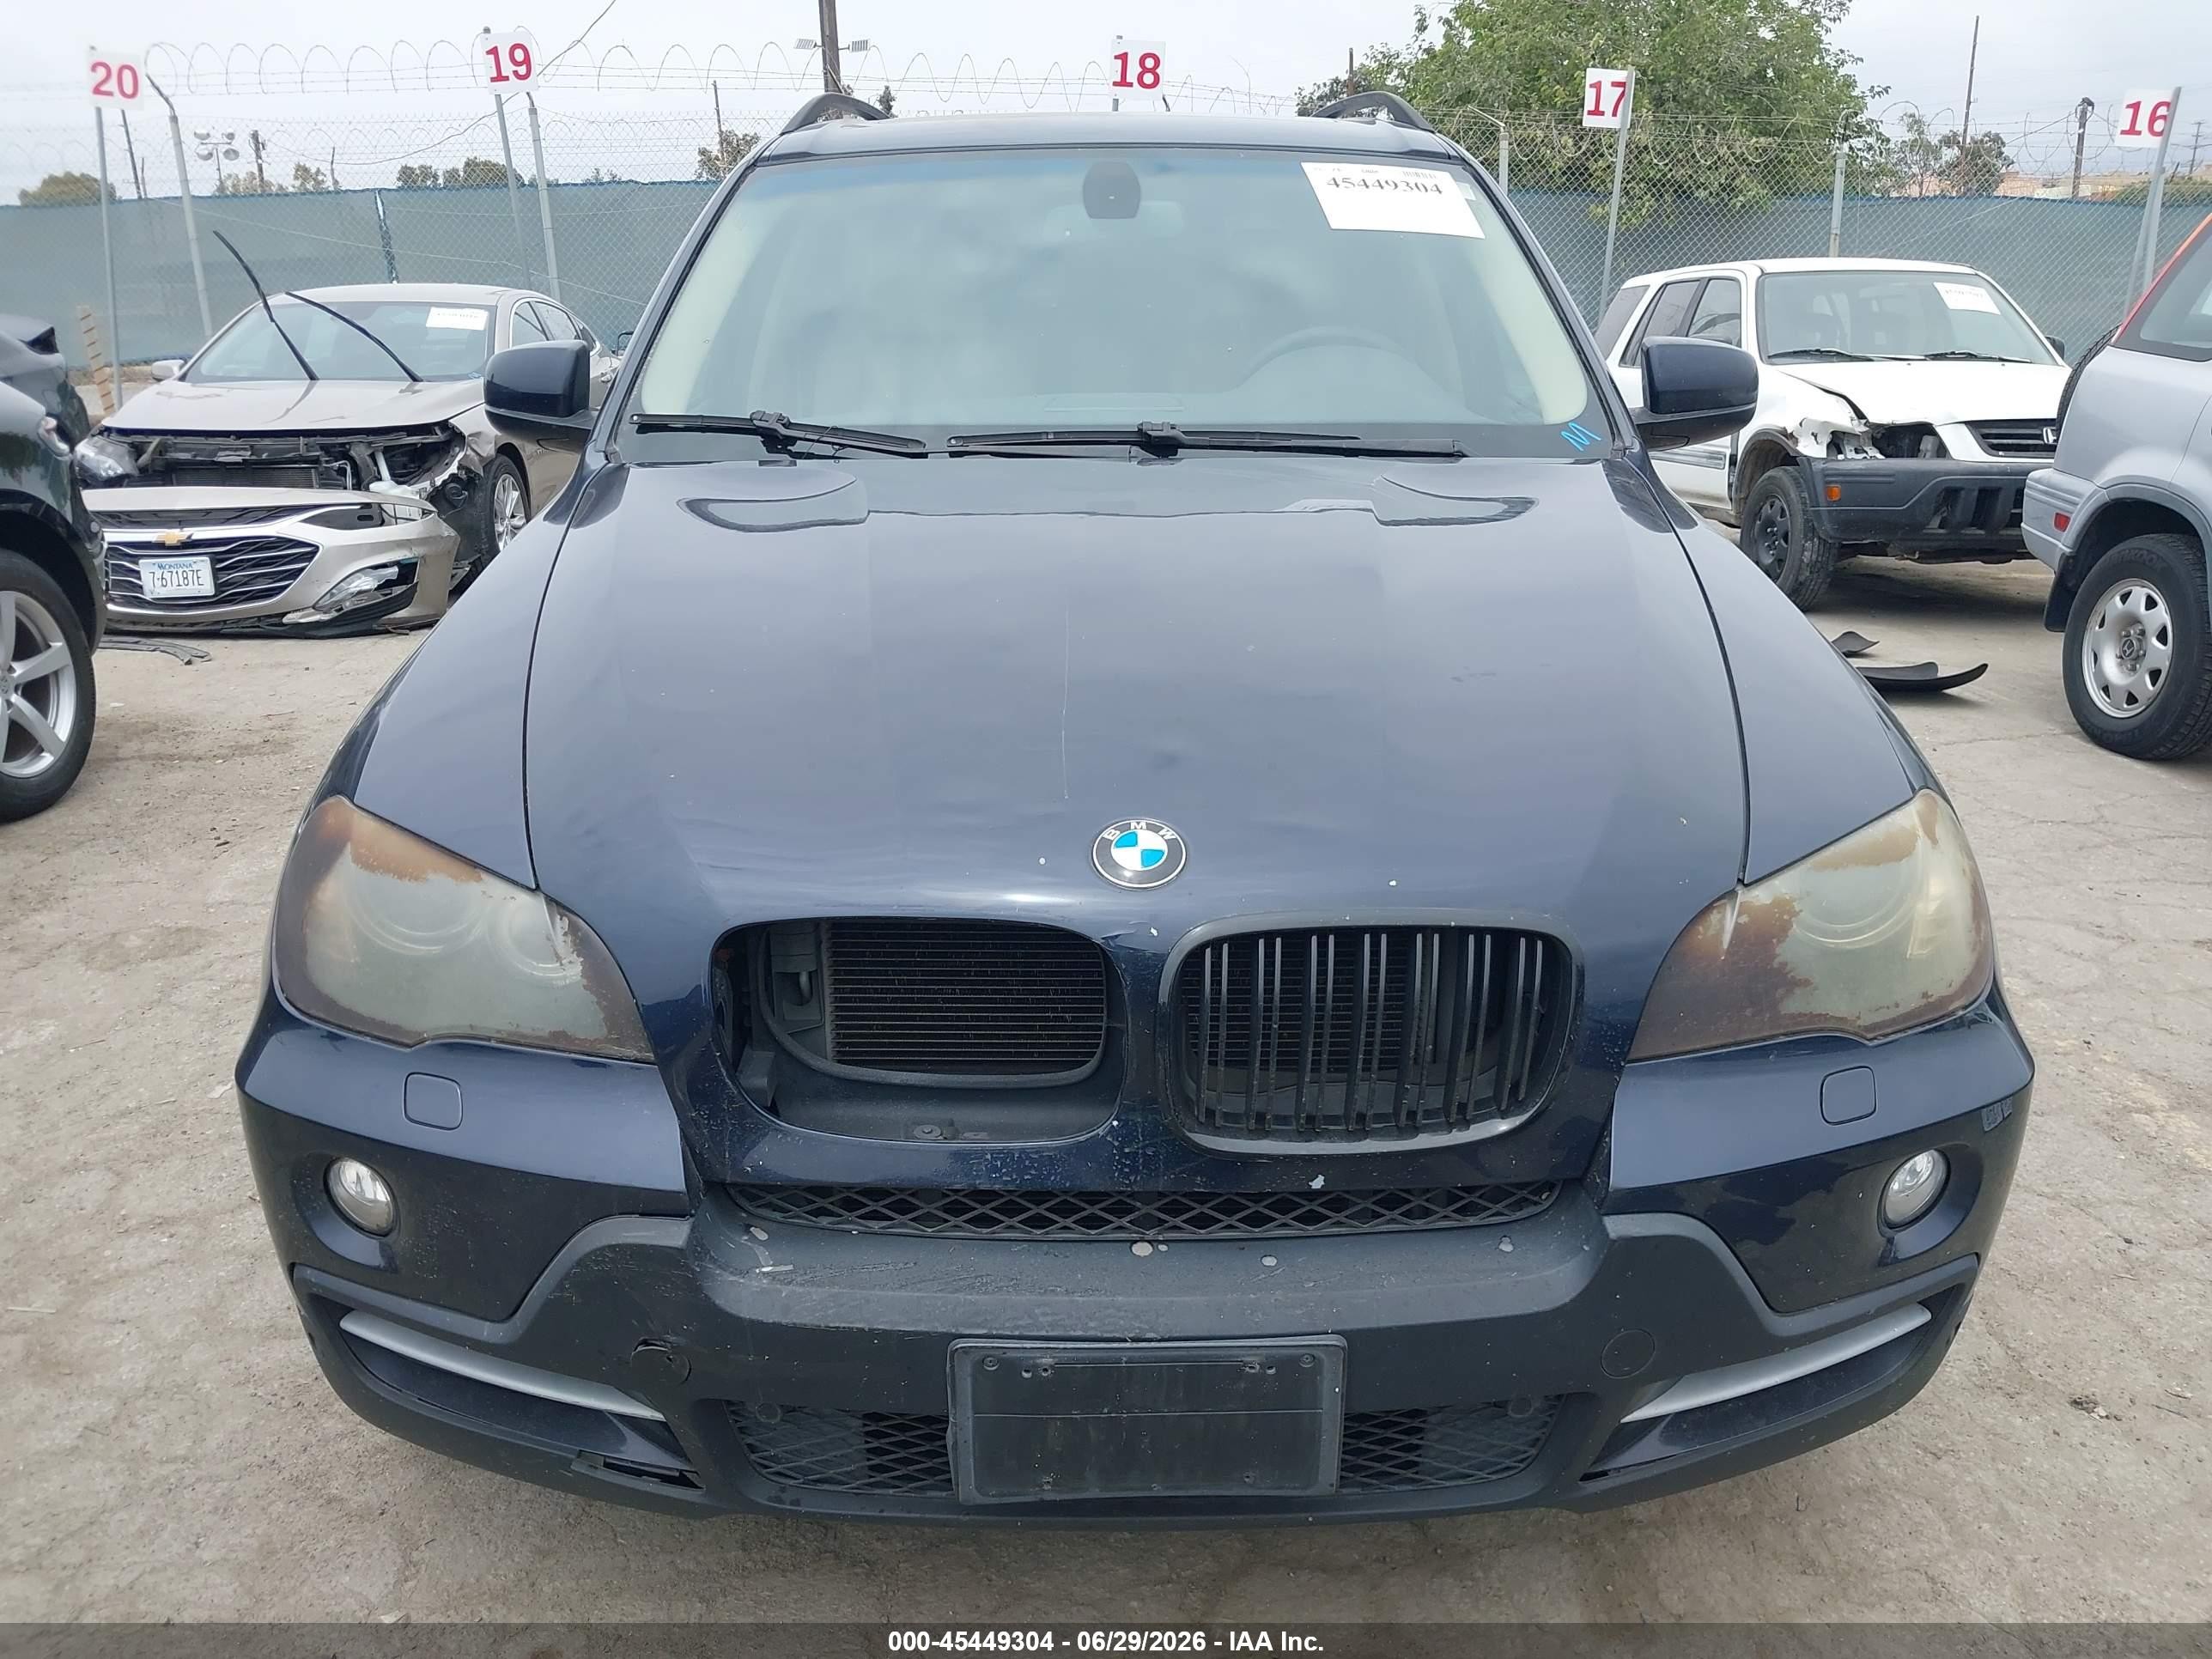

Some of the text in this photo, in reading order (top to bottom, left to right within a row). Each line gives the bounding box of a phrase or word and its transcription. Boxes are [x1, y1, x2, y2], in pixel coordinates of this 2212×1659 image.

[90, 61, 139, 100] 20
[485, 42, 532, 83] 19
[1112, 52, 1161, 89] 18
[1586, 80, 1626, 118] 17
[2119, 100, 2172, 137] 16
[1327, 176, 1443, 195] 45449304
[1102, 821, 1176, 842] BMW
